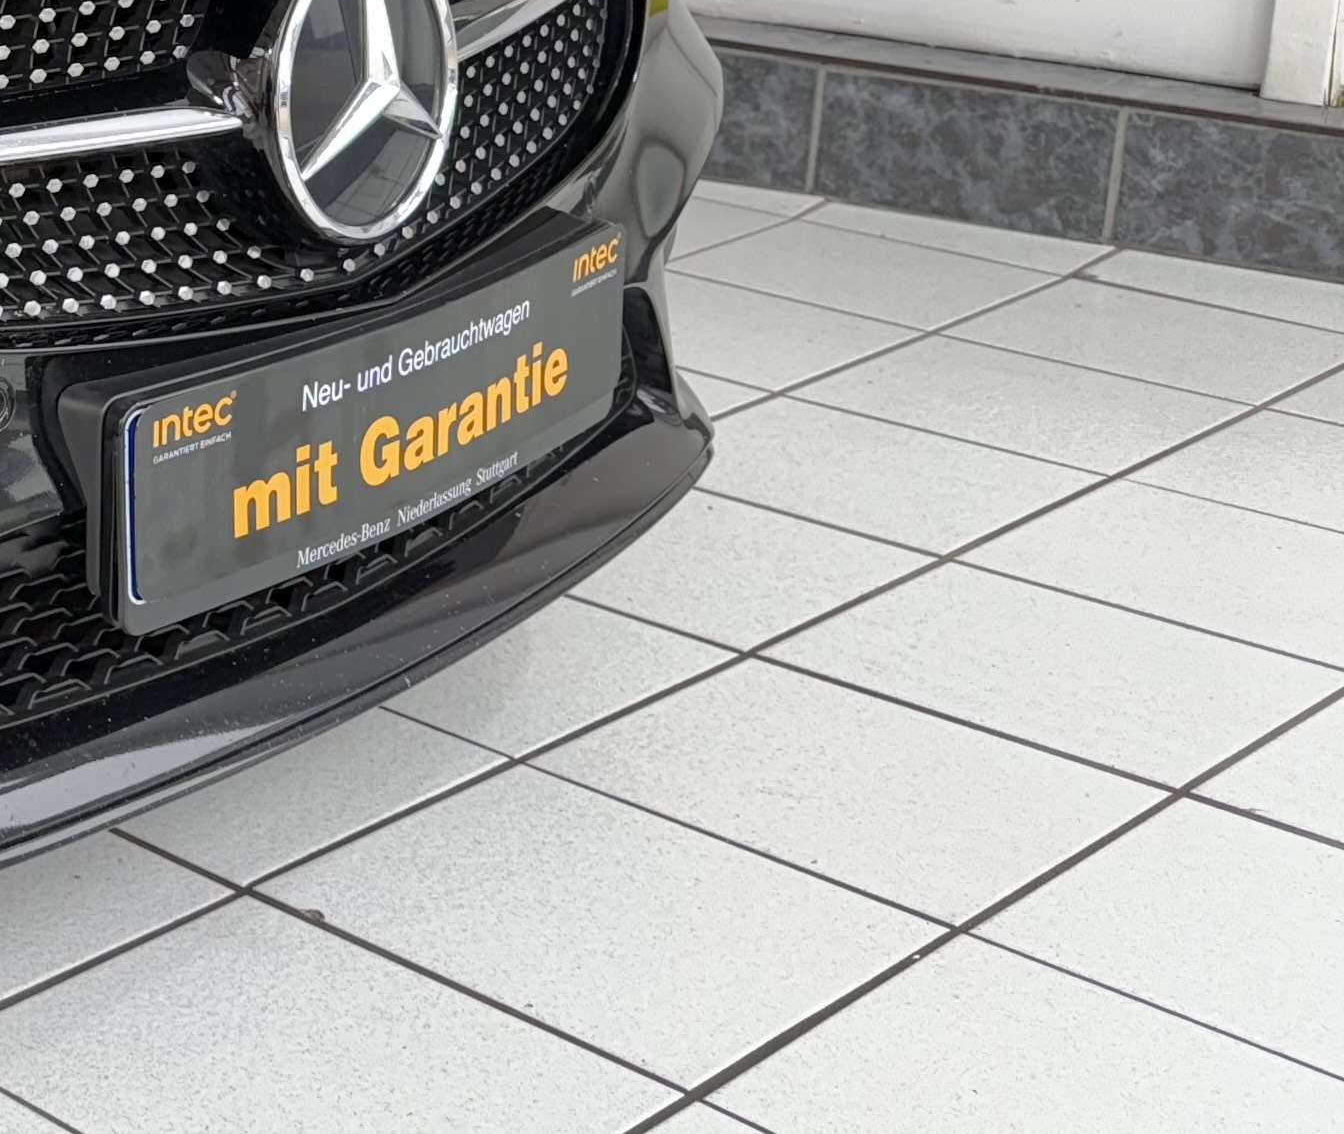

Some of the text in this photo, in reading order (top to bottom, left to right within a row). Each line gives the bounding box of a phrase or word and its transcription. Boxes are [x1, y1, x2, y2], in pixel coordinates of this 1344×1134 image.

[301, 299, 531, 412] Neu- und Gebrauchtwagen
[153, 430, 232, 465] GARANTIERT EINFACH
[233, 341, 569, 539] mit Garantie
[296, 450, 519, 569] Mercedes-Benz Niederlassung Stuttgart
